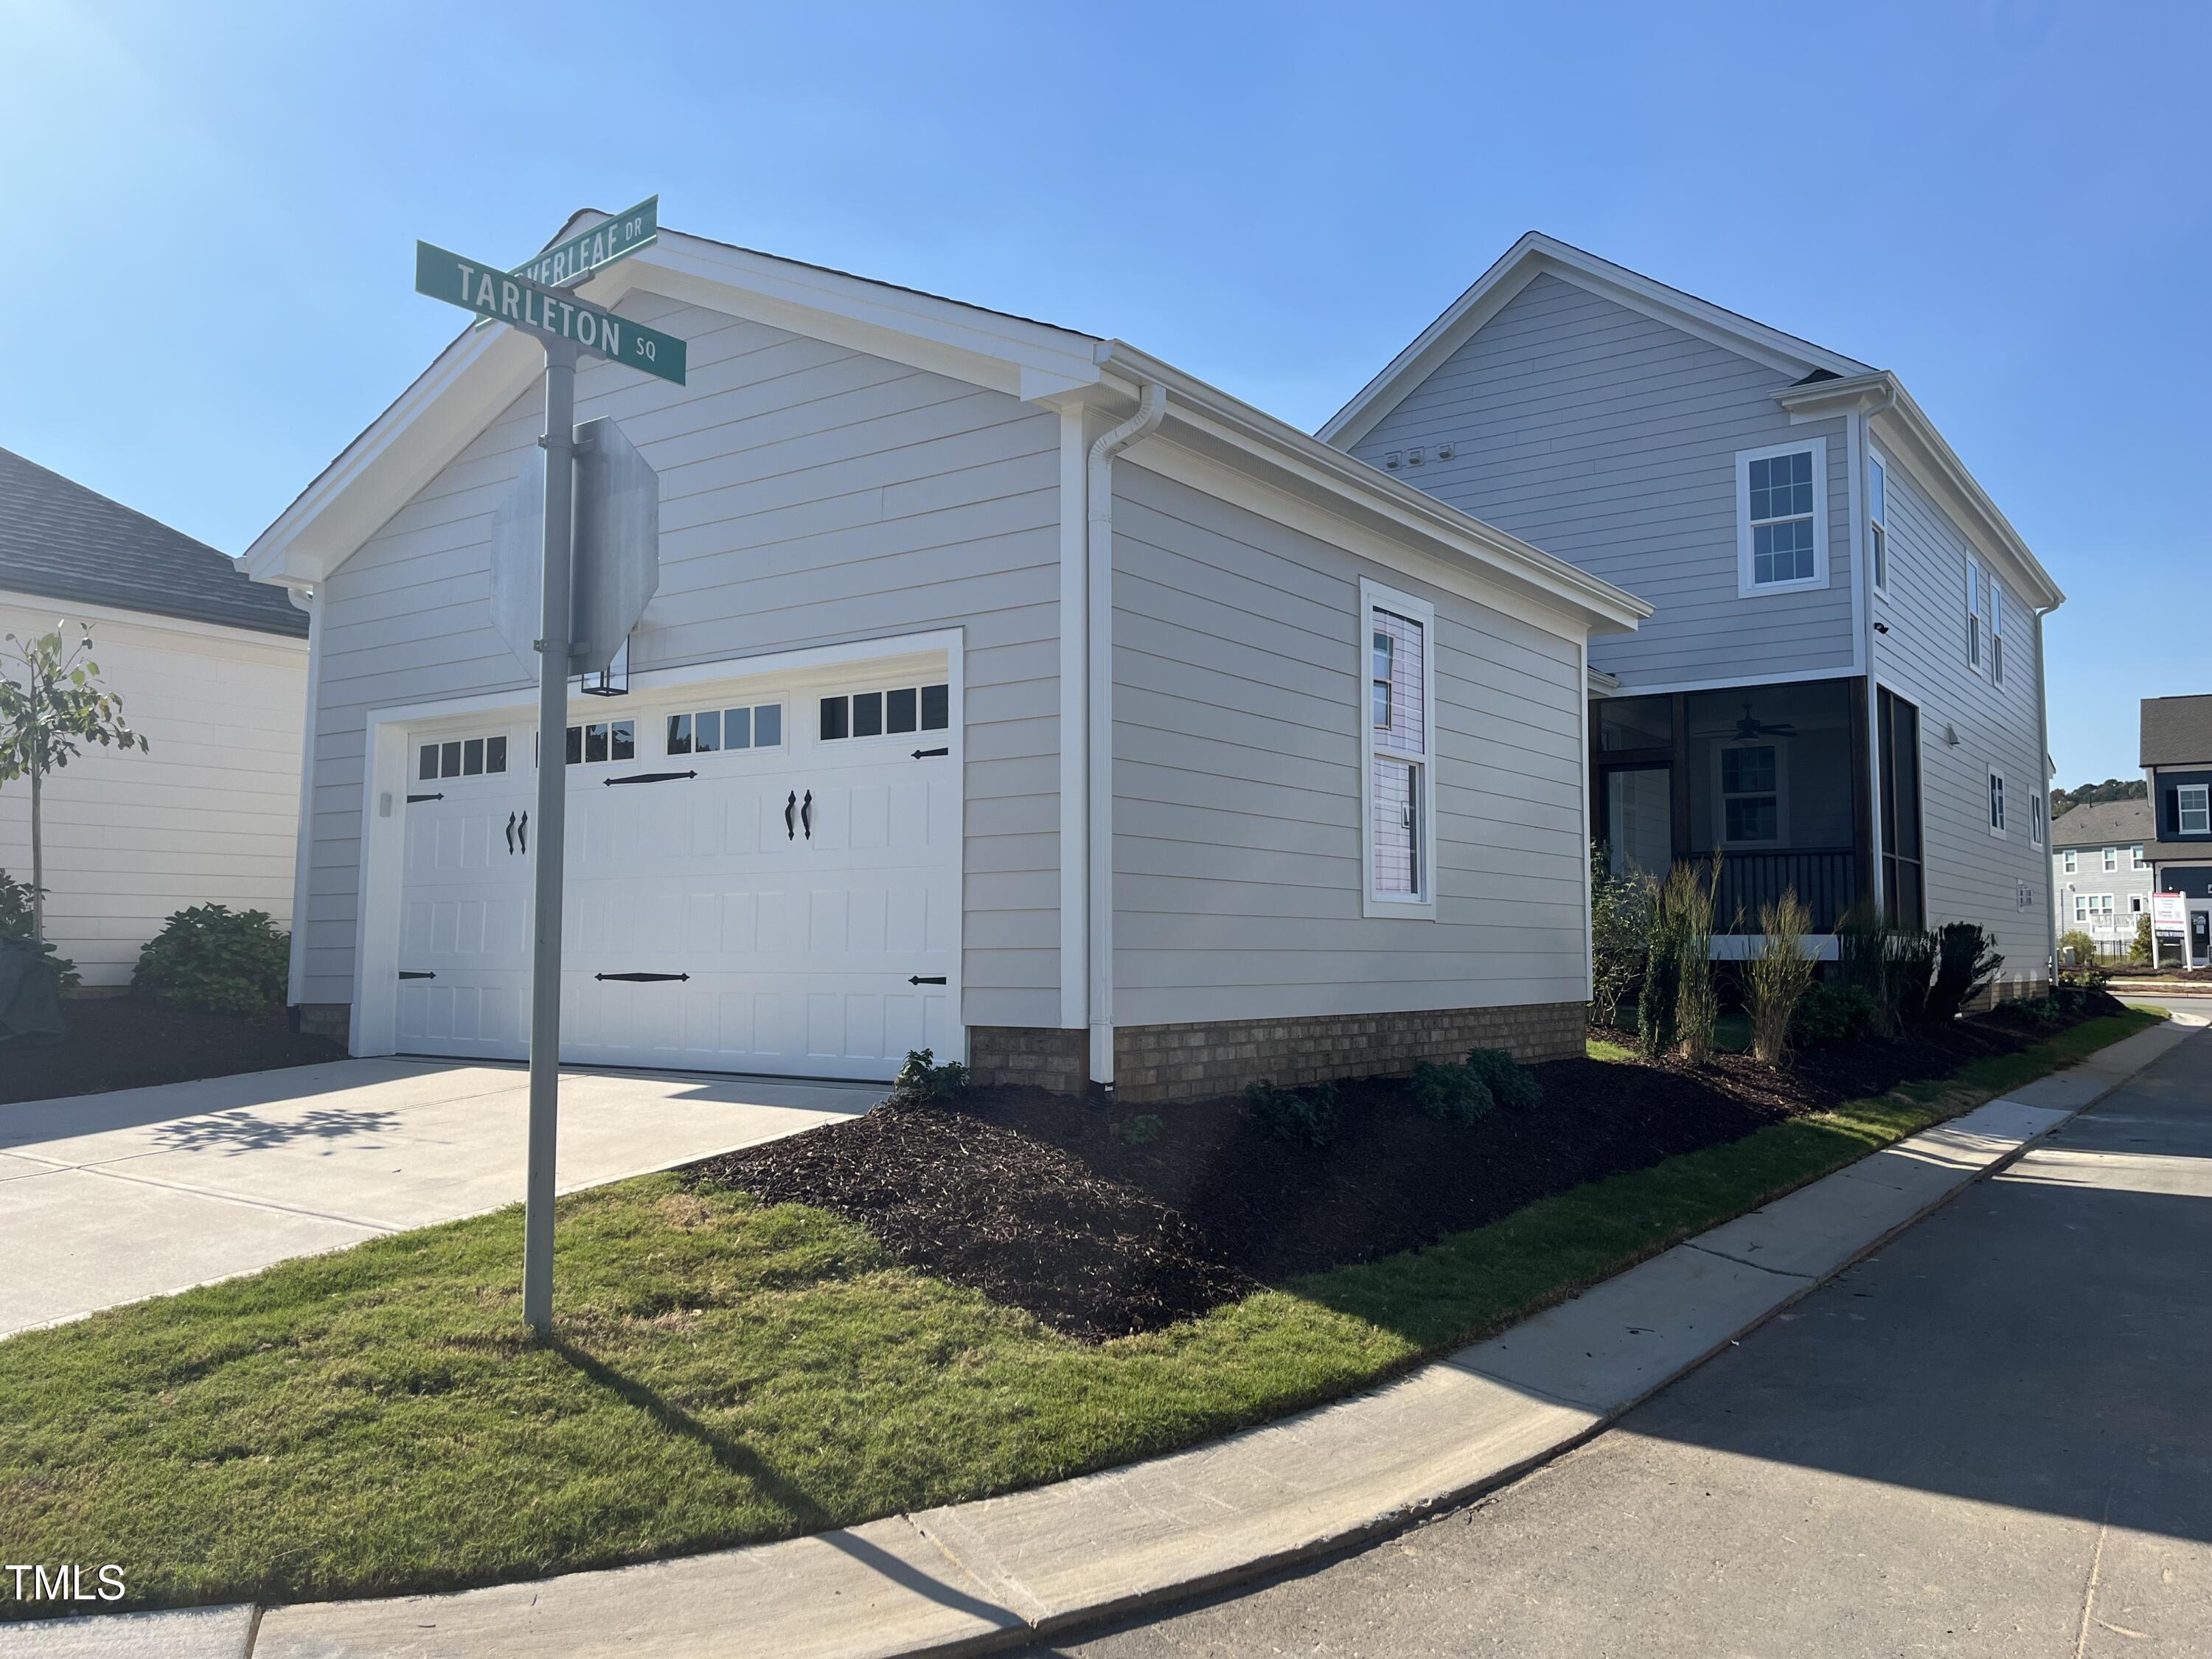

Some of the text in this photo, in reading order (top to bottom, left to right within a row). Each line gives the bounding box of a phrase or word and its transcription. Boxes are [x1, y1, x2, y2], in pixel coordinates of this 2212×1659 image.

[626, 218, 641, 240] DR
[458, 263, 655, 361] TARLETON SQ
